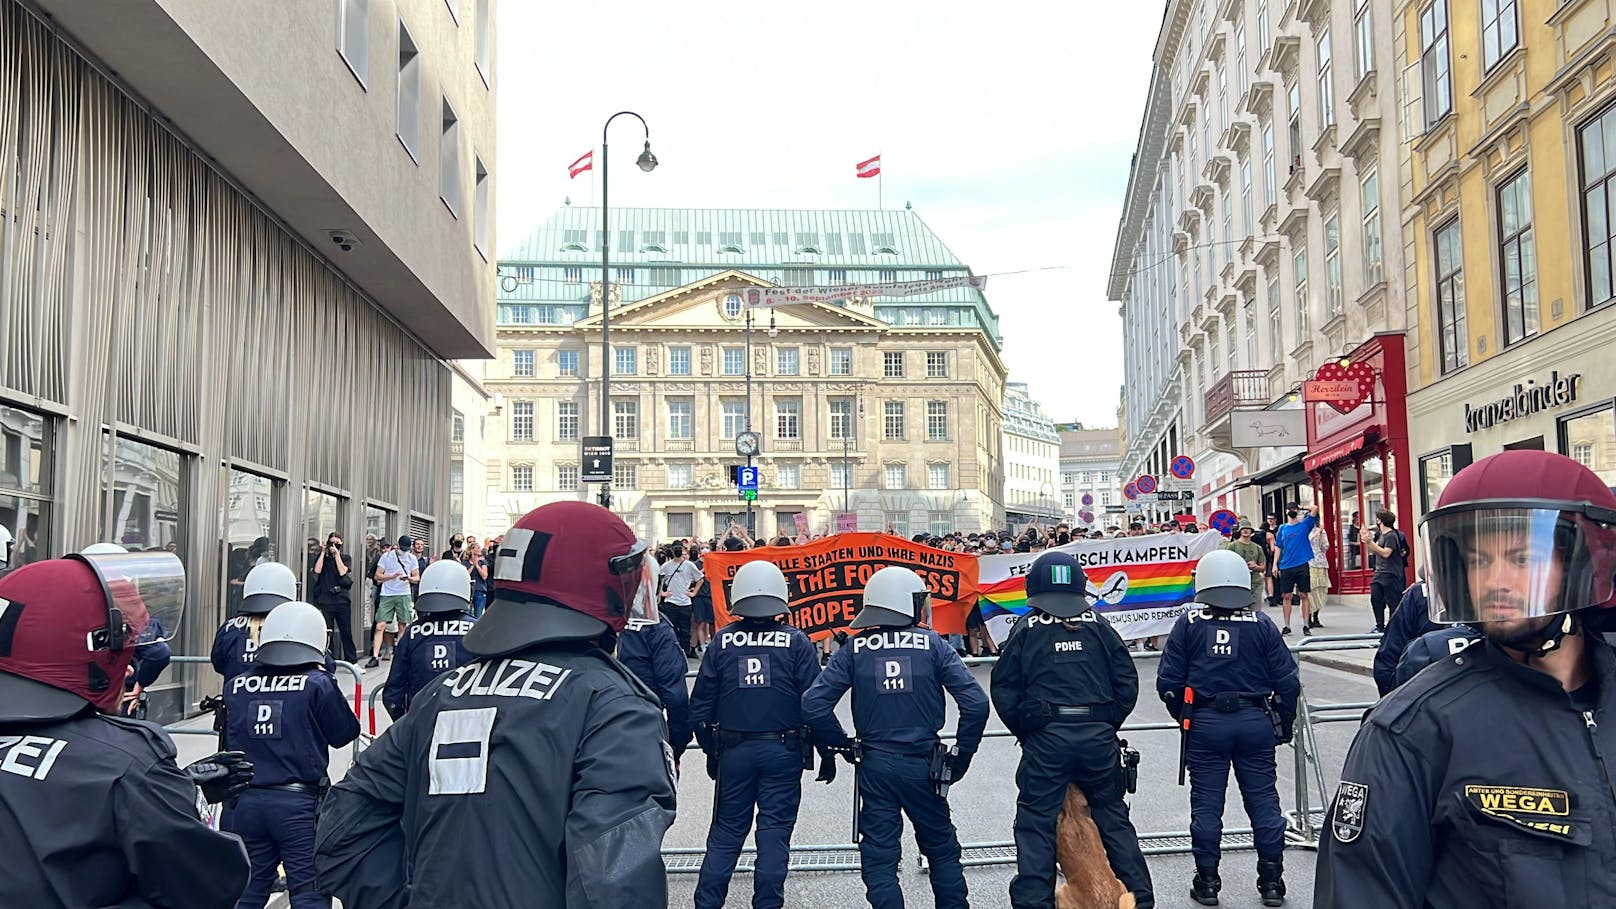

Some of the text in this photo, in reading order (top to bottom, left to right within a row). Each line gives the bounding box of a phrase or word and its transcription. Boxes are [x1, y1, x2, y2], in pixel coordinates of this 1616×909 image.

[765, 288, 790, 296] Fest
[802, 290, 857, 302] September
[1310, 384, 1353, 393] Herzilein
[804, 547, 854, 569] STAATEN
[858, 546, 883, 558] UND
[888, 547, 915, 560] IHRE
[920, 552, 954, 568] NAZIS
[796, 566, 838, 594] THE
[1133, 611, 1149, 622] UND
[1188, 605, 1258, 623] POZEI
[722, 631, 791, 649] POLIZEI
[853, 632, 930, 653] POLIZEI
[1216, 629, 1230, 644] D
[245, 638, 258, 652] D
[434, 644, 447, 659] D
[1054, 641, 1082, 651] PDHE
[1212, 644, 1232, 655] 111
[431, 659, 449, 668] 111
[747, 658, 761, 673] D
[885, 661, 901, 677] D
[232, 674, 308, 694] POLIZEI
[744, 674, 764, 685] 111
[883, 678, 905, 689] 111
[257, 704, 272, 722] D
[254, 723, 274, 734] 111
[1341, 784, 1364, 799] WEGA
[1480, 793, 1555, 813] WEGA
